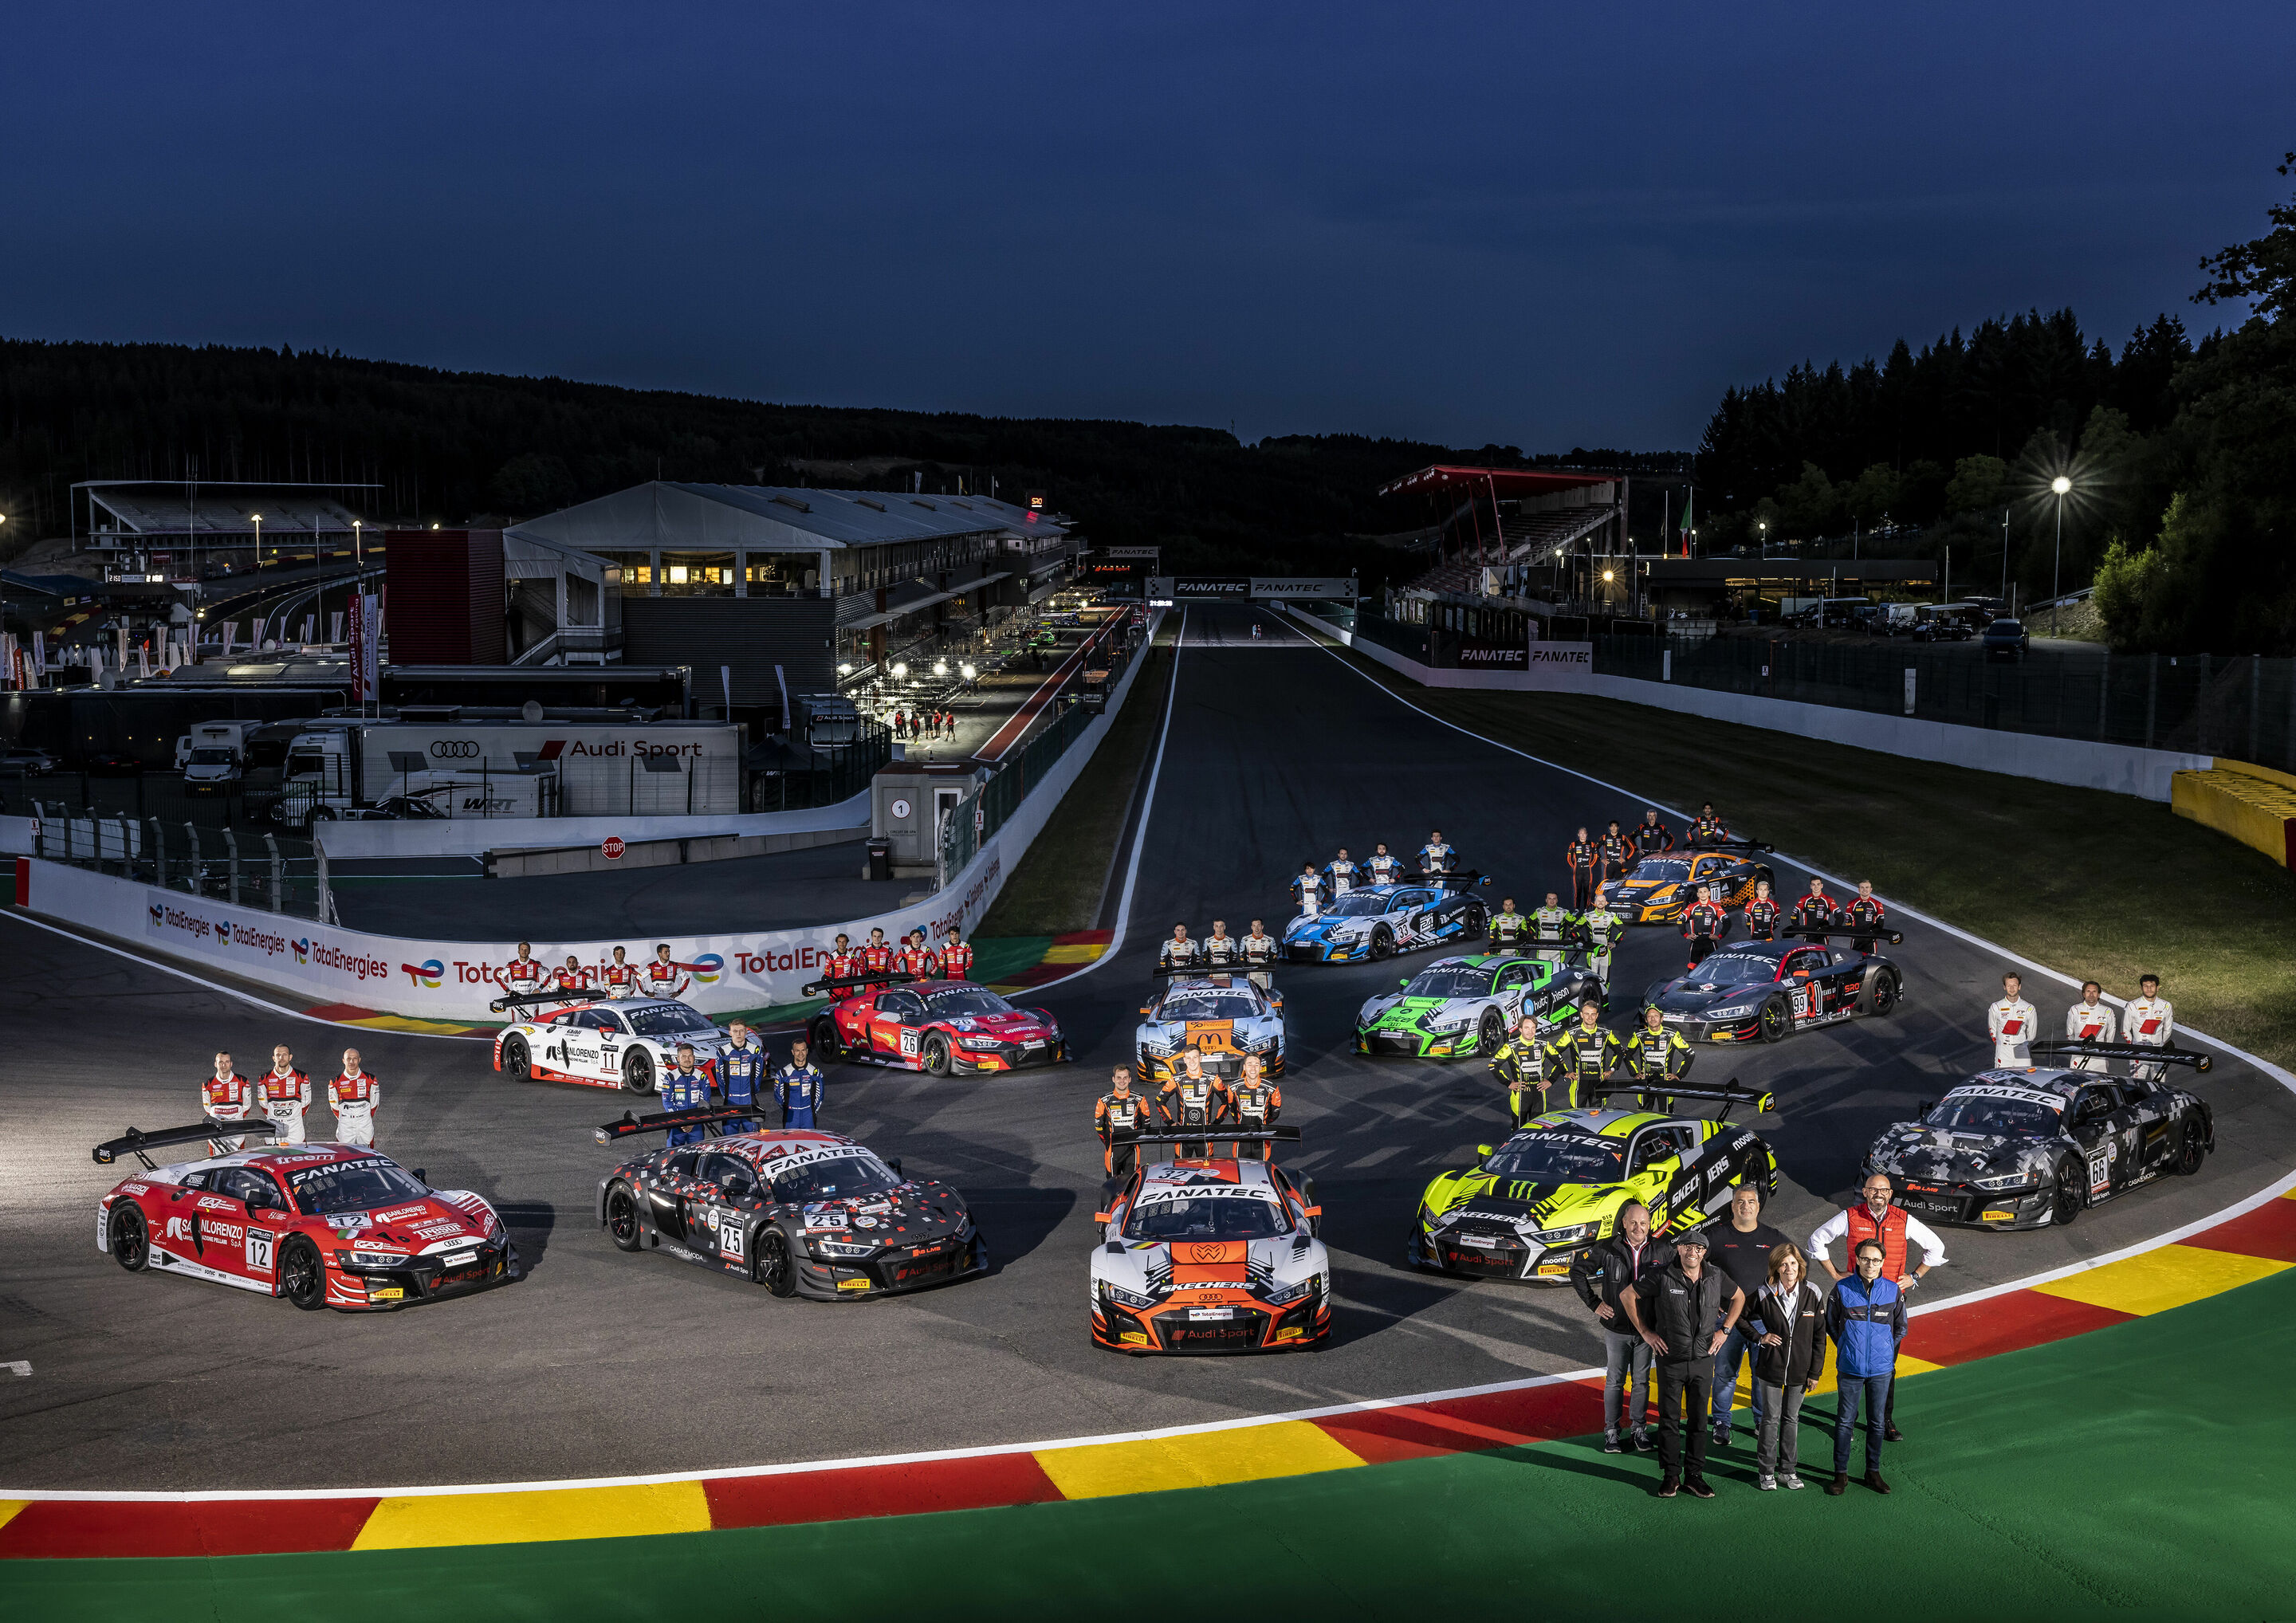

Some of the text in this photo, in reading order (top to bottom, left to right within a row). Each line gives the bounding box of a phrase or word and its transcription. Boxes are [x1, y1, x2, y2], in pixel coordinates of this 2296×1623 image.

[1176, 583, 1246, 591] FANATEC
[350, 647, 360, 678] Audi
[1461, 650, 1526, 661] FANATEC
[1532, 651, 1590, 662] FANATEC
[570, 741, 702, 760] Audi Sport
[462, 798, 517, 811] WRT
[898, 804, 903, 814] 1
[603, 843, 623, 853] STOP
[165, 907, 210, 937] TotalEnergies
[232, 924, 285, 956] TotalEnergies
[312, 941, 387, 980] TotalEnergies
[1705, 953, 1779, 964] FANATEC
[1419, 968, 1492, 977] FANATEC
[926, 987, 989, 1002] FANATEC
[1845, 982, 1860, 992] SRO
[1169, 990, 1249, 1001] FANATEC
[493, 1000, 504, 1009] aws
[1794, 996, 1805, 1013] 99
[630, 1005, 693, 1020] FANATEC
[903, 1035, 915, 1052] 26
[603, 1052, 615, 1069] 11
[1948, 1087, 2057, 1105] FANATEC
[1508, 1132, 1618, 1150] FANATEC
[99, 1149, 111, 1157] aws
[769, 1148, 868, 1174] FANATEC
[291, 1158, 394, 1185] FANATEC
[1158, 1169, 1188, 1181] 32
[2092, 1159, 2105, 1185] 66
[1140, 1188, 1269, 1204] FANATEC
[387, 1204, 427, 1218] SANLORENZO
[1903, 1199, 1958, 1213] Audi Sport
[336, 1216, 364, 1227] 12
[812, 1214, 841, 1228] 25
[1448, 1209, 1530, 1226] SKECHERS
[1650, 1201, 1668, 1232] 46
[1701, 1215, 1721, 1228] FANATEC
[182, 1218, 243, 1240] SANLORENZO
[723, 1227, 741, 1253] 25
[250, 1240, 268, 1267] 12
[669, 1244, 703, 1262] CASA MODA
[1459, 1254, 1515, 1267] Audi Sport
[1542, 1256, 1571, 1265] mooney
[909, 1258, 957, 1277] Audi Sport
[1540, 1265, 1568, 1275] PIRELLI
[442, 1267, 491, 1285] Audi Sport
[1158, 1281, 1257, 1295] SKECHERS
[1121, 1332, 1146, 1344] PIRELLI
[1188, 1326, 1255, 1341] Audi Sport
[1278, 1326, 1302, 1339] PIRELLI
